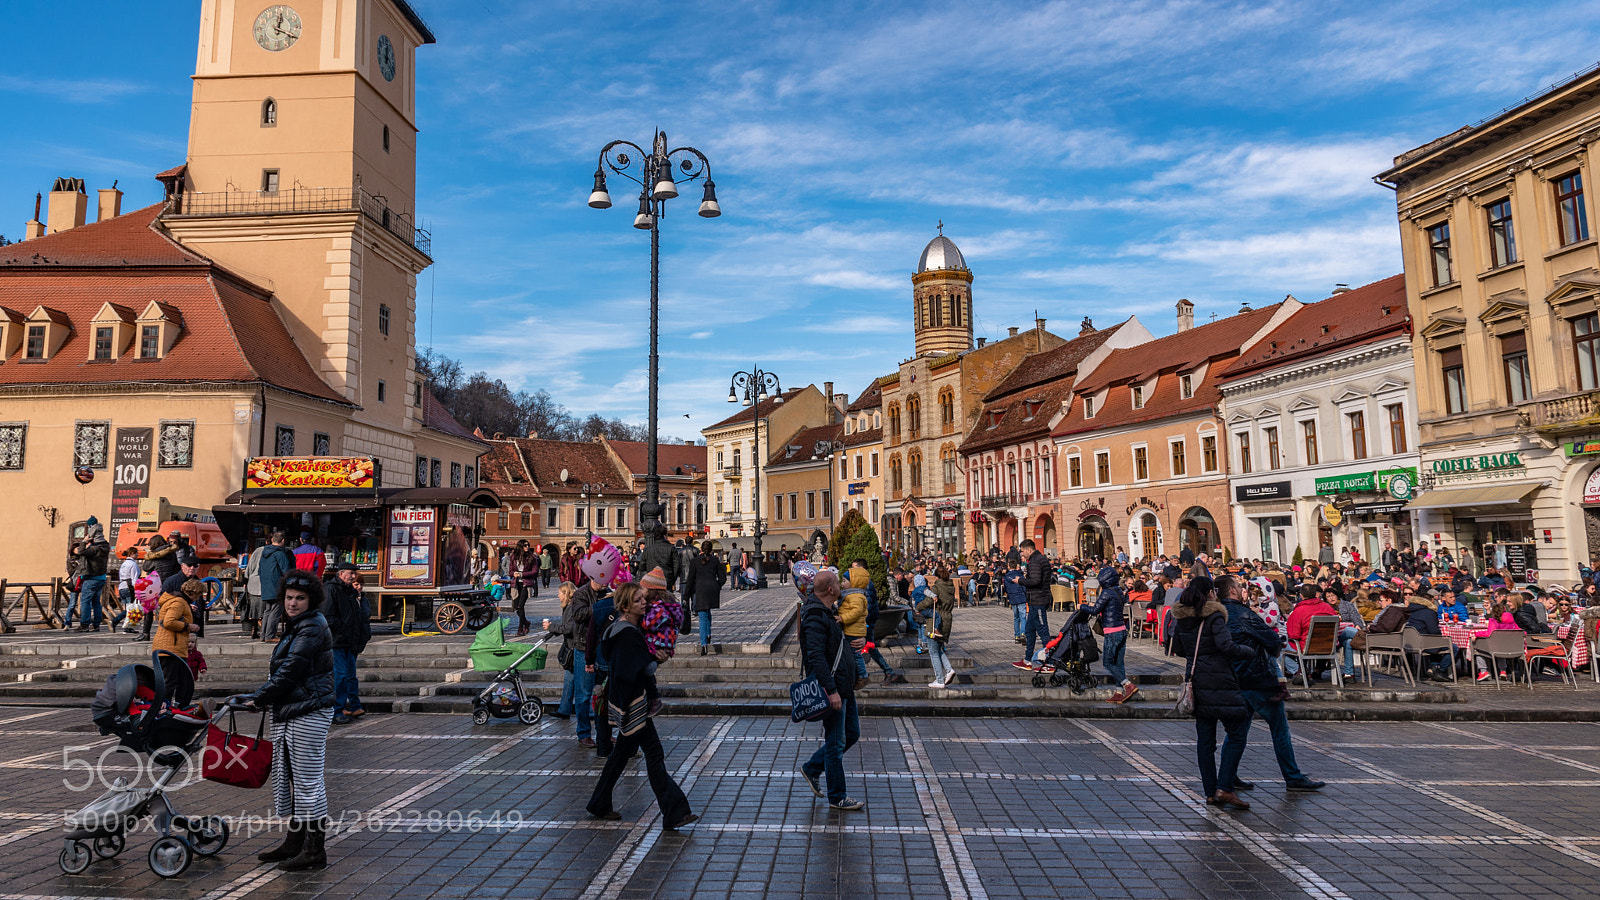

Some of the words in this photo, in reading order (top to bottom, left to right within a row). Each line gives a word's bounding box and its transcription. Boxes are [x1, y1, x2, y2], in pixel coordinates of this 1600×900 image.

[1478, 452, 1522, 469] BACK
[114, 464, 148, 485] 100
[276, 473, 344, 486] Kalács
[393, 511, 408, 521] VIN
[409, 511, 433, 521] FIERT
[970, 510, 987, 523] KFC
[805, 700, 827, 714] COOPER
